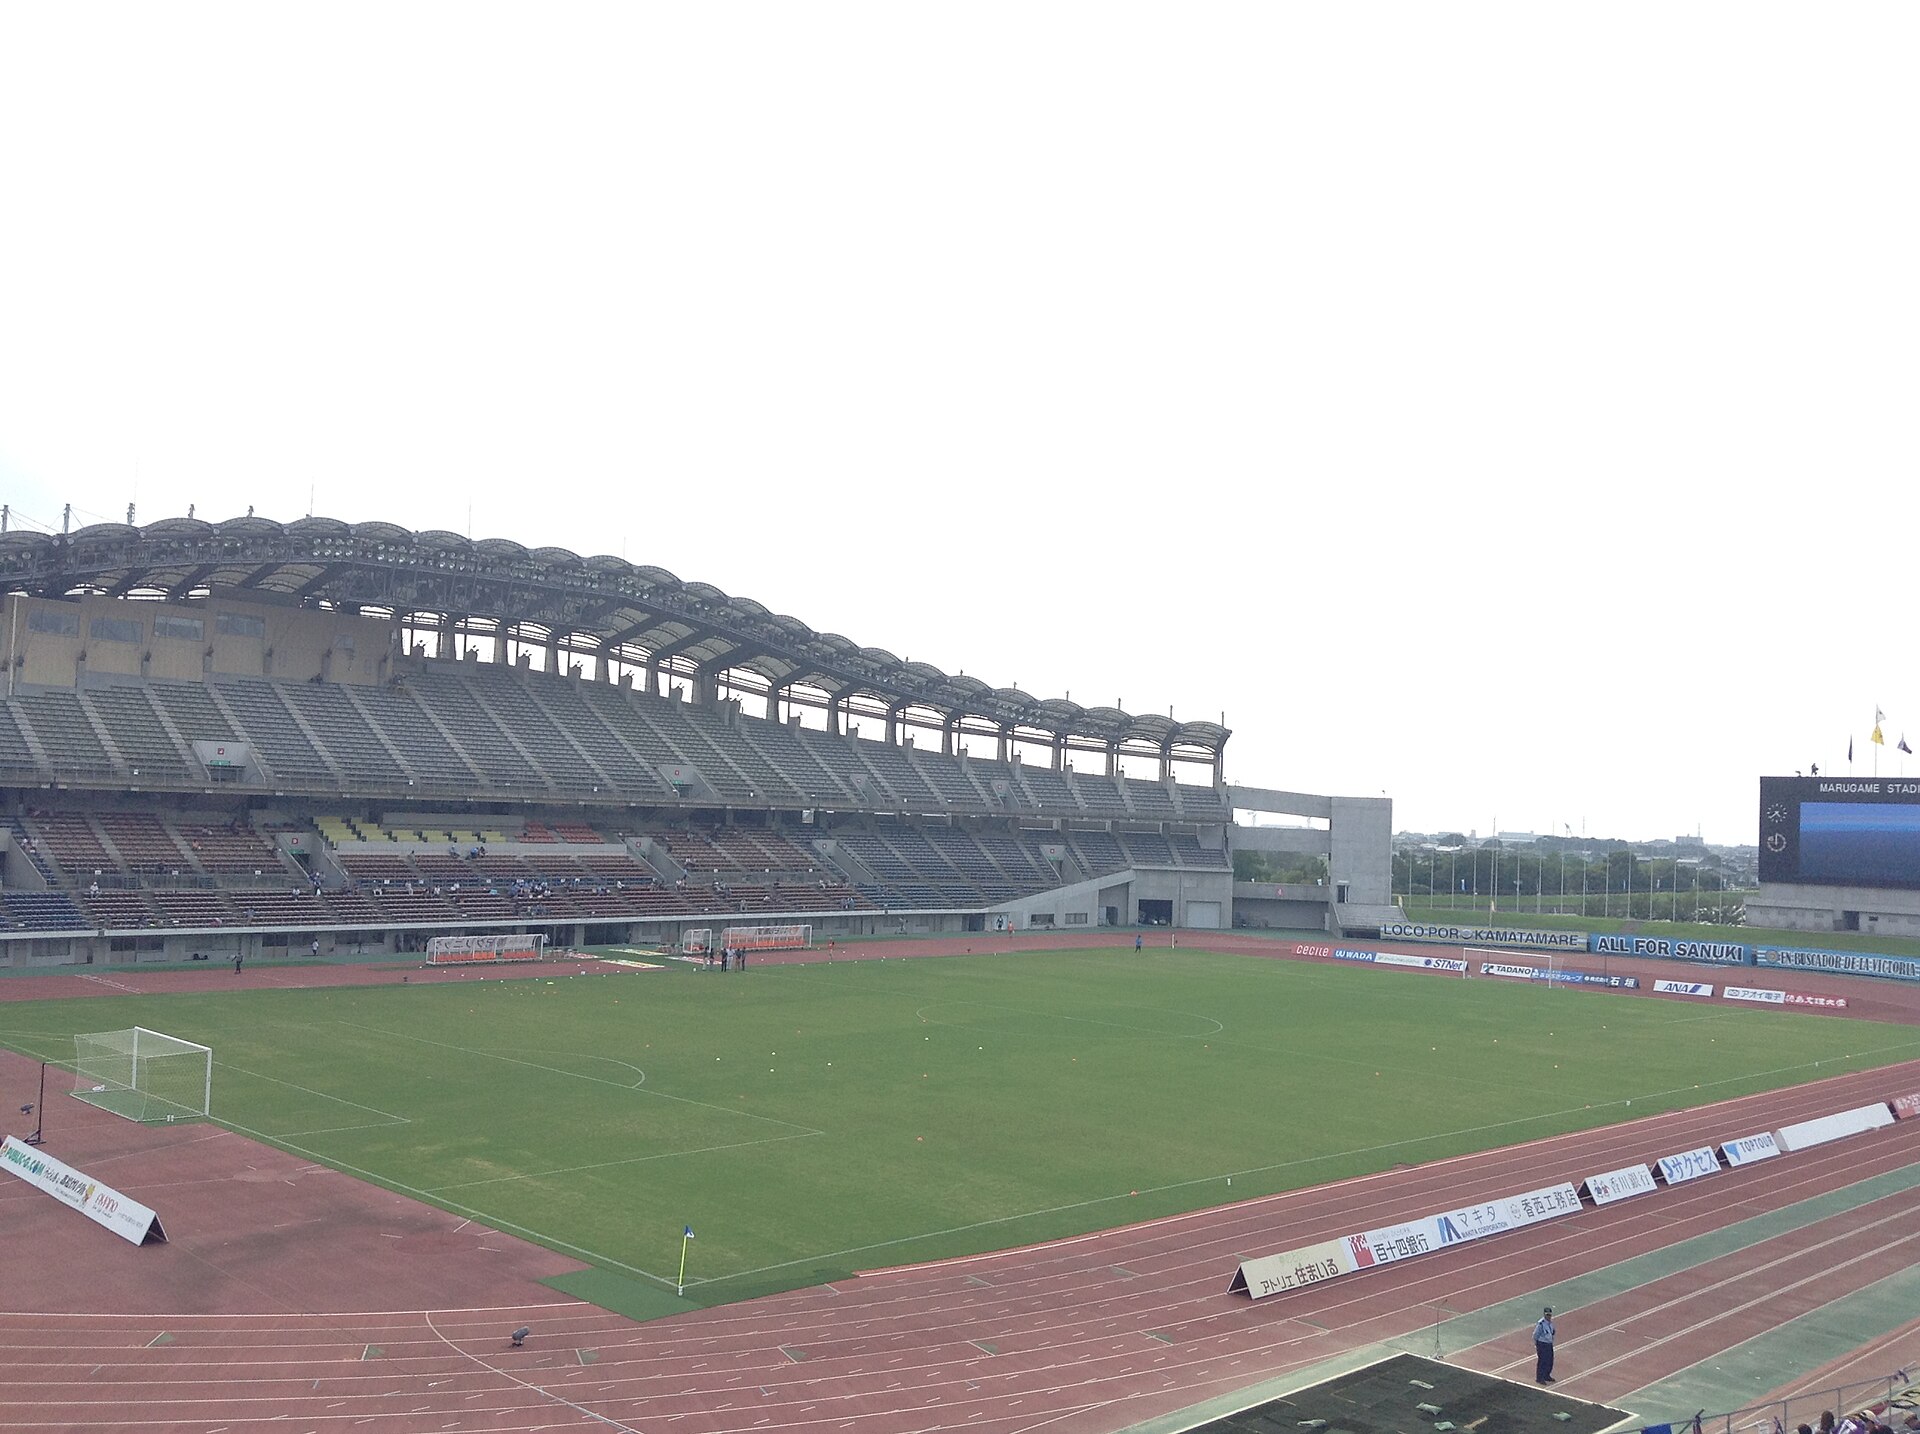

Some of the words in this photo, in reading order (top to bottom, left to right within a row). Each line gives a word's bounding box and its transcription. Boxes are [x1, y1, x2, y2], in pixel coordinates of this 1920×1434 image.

[1819, 783, 1880, 793] MARUGAME
[1383, 924, 1425, 937] LOCO
[1428, 926, 1459, 939] POR
[1474, 929, 1578, 946] KAMATAMARE
[1346, 951, 1373, 960] WADA
[1597, 936, 1630, 953] ALL
[1633, 938, 1671, 956] FOR
[1674, 942, 1744, 961] SANUKI
[1433, 959, 1463, 970] STNet
[1496, 965, 1531, 975] TADANO
[1780, 951, 1792, 964] EN
[1794, 952, 1842, 968] BUSCADOR
[1844, 955, 1857, 969] DE
[1859, 956, 1870, 970] LA
[1872, 958, 1916, 976] VICTORIA
[1610, 976, 1635, 988] 石垣
[1664, 983, 1688, 993] ANA
[1741, 990, 1781, 1000] アオイ電子
[1739, 1135, 1774, 1153] TOPTOUR
[1672, 1150, 1718, 1179] サクセス
[1610, 1169, 1650, 1193] 香川銀行
[1521, 1189, 1577, 1218] 香西工務店
[1457, 1206, 1496, 1227] マキタ
[1373, 1233, 1429, 1262] 百十四銀行
[1260, 1276, 1295, 1294] アトリエ
[1295, 1258, 1339, 1284] 住まいる
